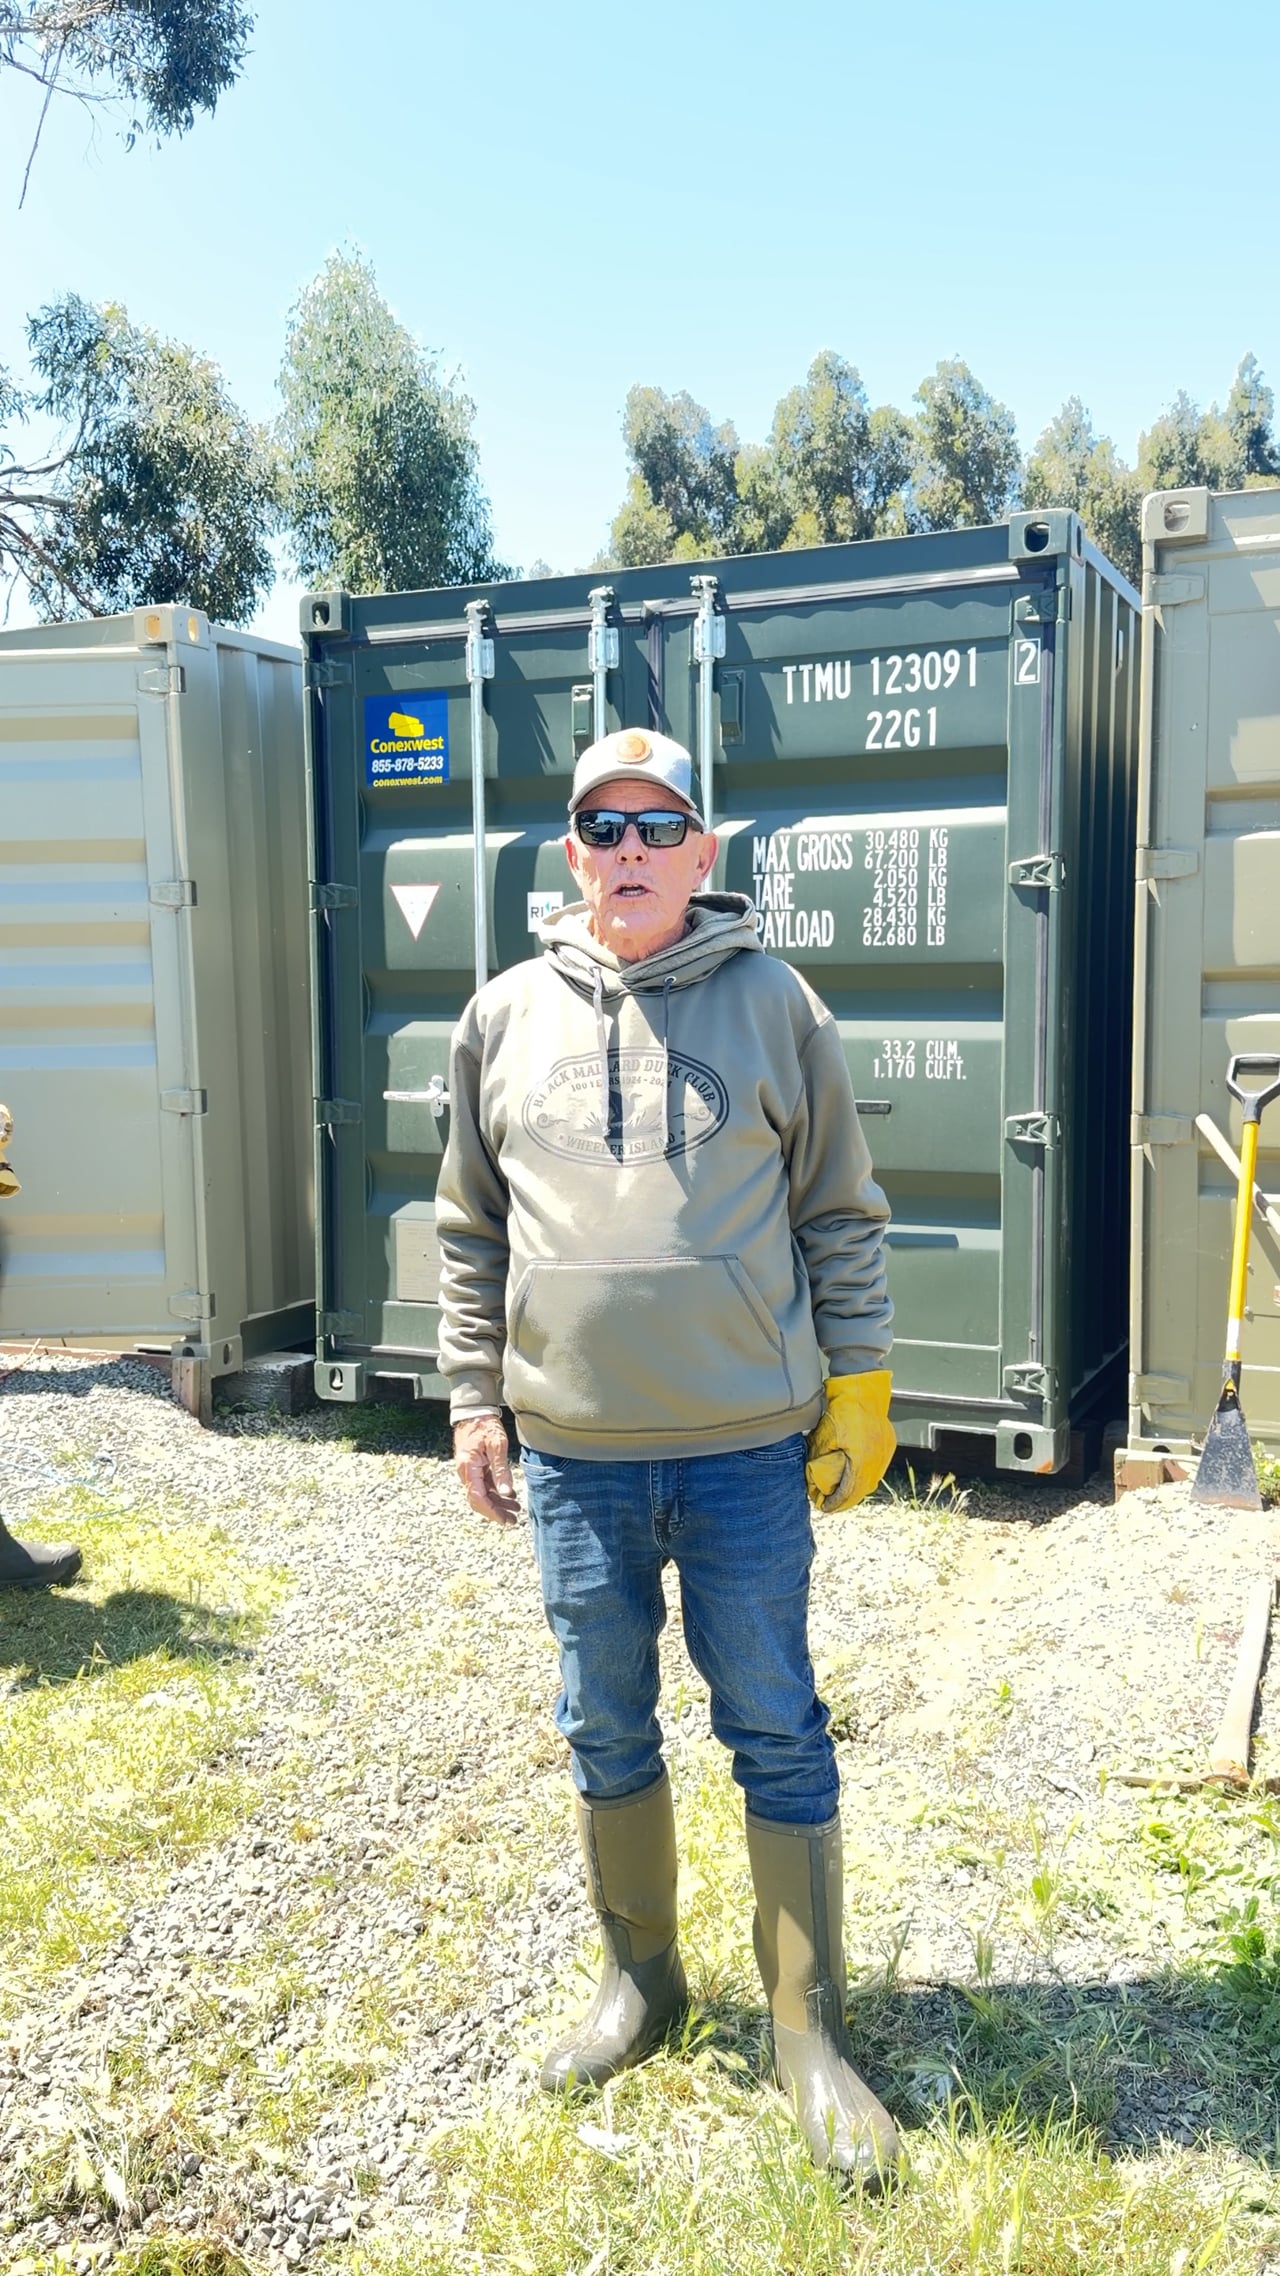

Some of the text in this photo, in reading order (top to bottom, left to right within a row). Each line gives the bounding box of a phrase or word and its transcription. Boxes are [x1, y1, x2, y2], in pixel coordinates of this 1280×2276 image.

[1018, 641, 1037, 682] 2
[782, 647, 977, 704] TTMU 123091
[865, 706, 937, 749] 22G1
[370, 735, 445, 753] Conexwest
[371, 755, 444, 773] 855-878-5233
[865, 828, 949, 850] 30,480 KG
[752, 833, 853, 873] MAX GROSS
[864, 847, 947, 869] 67,200 LB
[874, 867, 948, 888] 2,050 KG
[752, 872, 795, 911] TARE
[873, 887, 946, 907] 4,520 LB
[863, 906, 946, 928] 28,430 KG
[863, 926, 945, 946] 62,680 LB
[882, 1039, 916, 1060] 33.2
[873, 1058, 916, 1078] 1,170
[571, 1082, 588, 1092] 100
[590, 1076, 620, 1089] YERS
[572, 1058, 641, 1079] MALARD
[684, 1072, 716, 1102] CLUB
